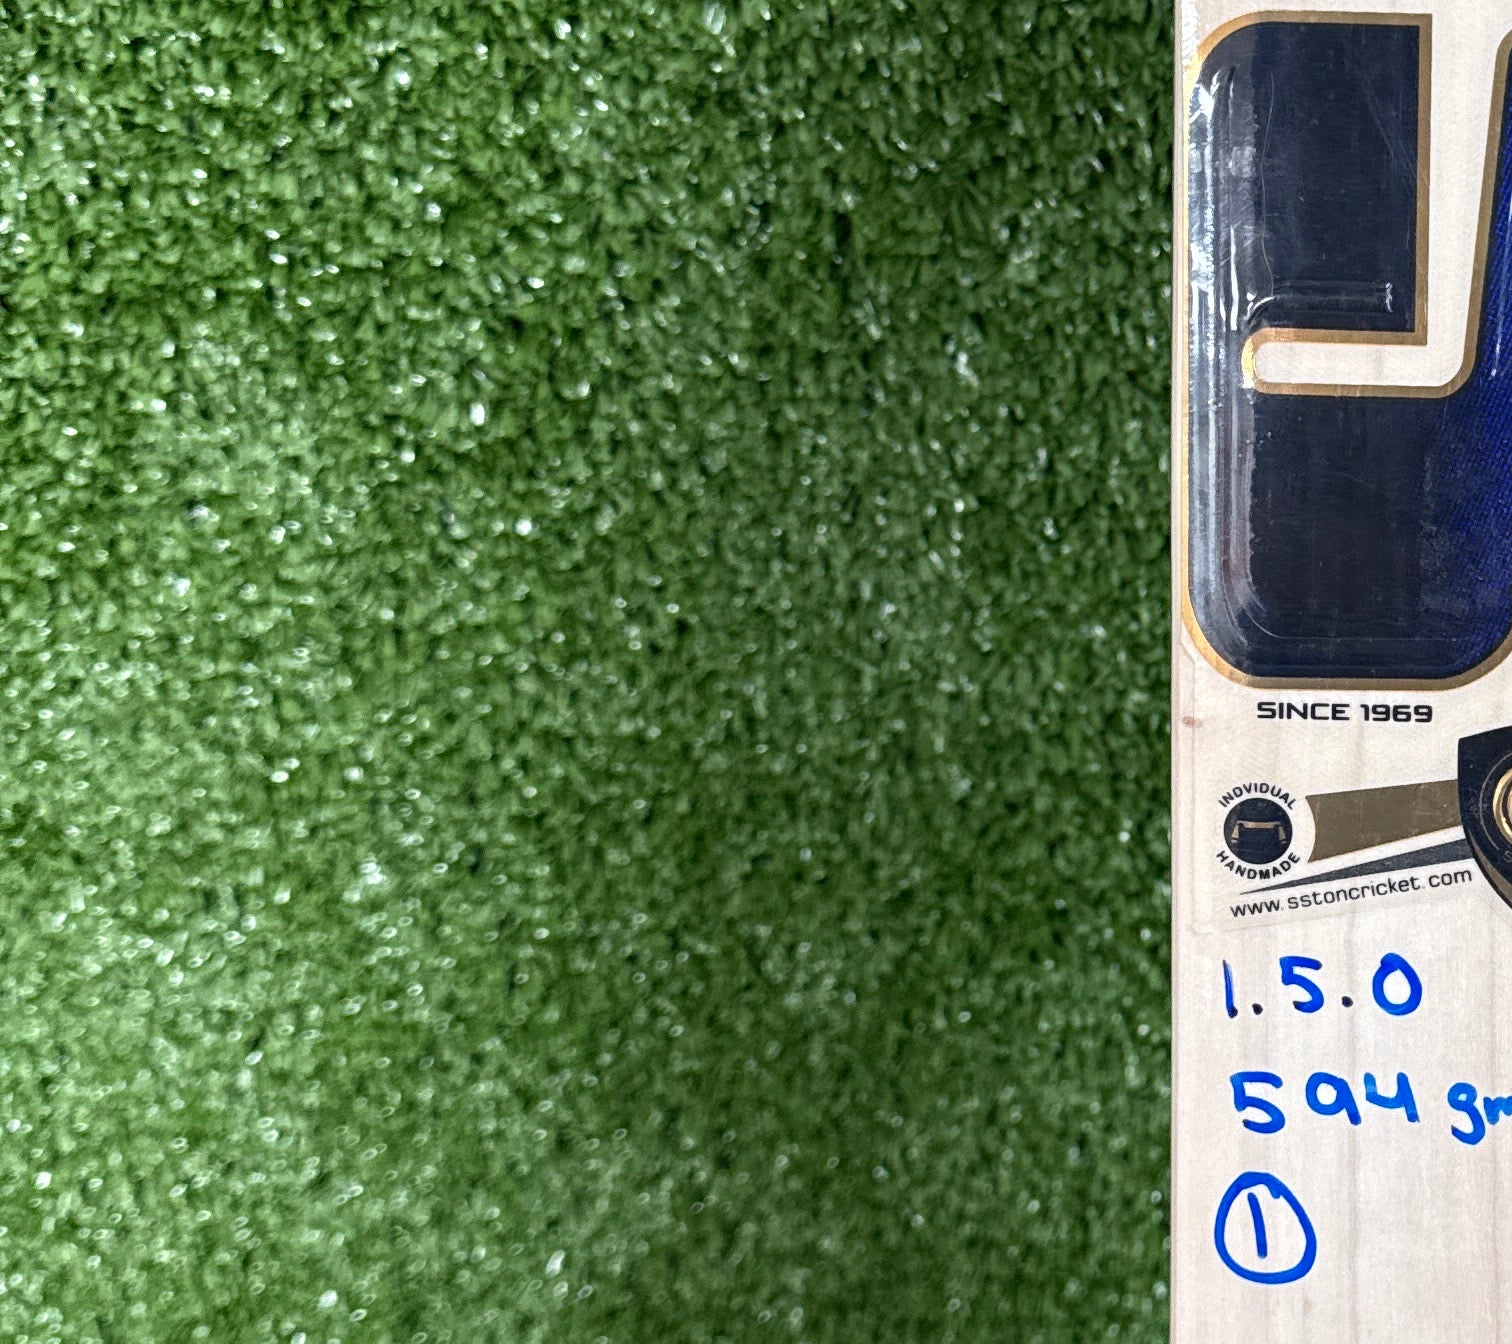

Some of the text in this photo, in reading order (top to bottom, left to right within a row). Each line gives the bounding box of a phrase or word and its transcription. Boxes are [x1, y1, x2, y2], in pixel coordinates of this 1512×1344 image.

[1256, 701, 1434, 724] SINCE 1969
[1215, 850, 1301, 881] HANDMADE
[1229, 868, 1474, 919] www.sstoncricket.com
[1230, 1071, 1420, 1134] 594
